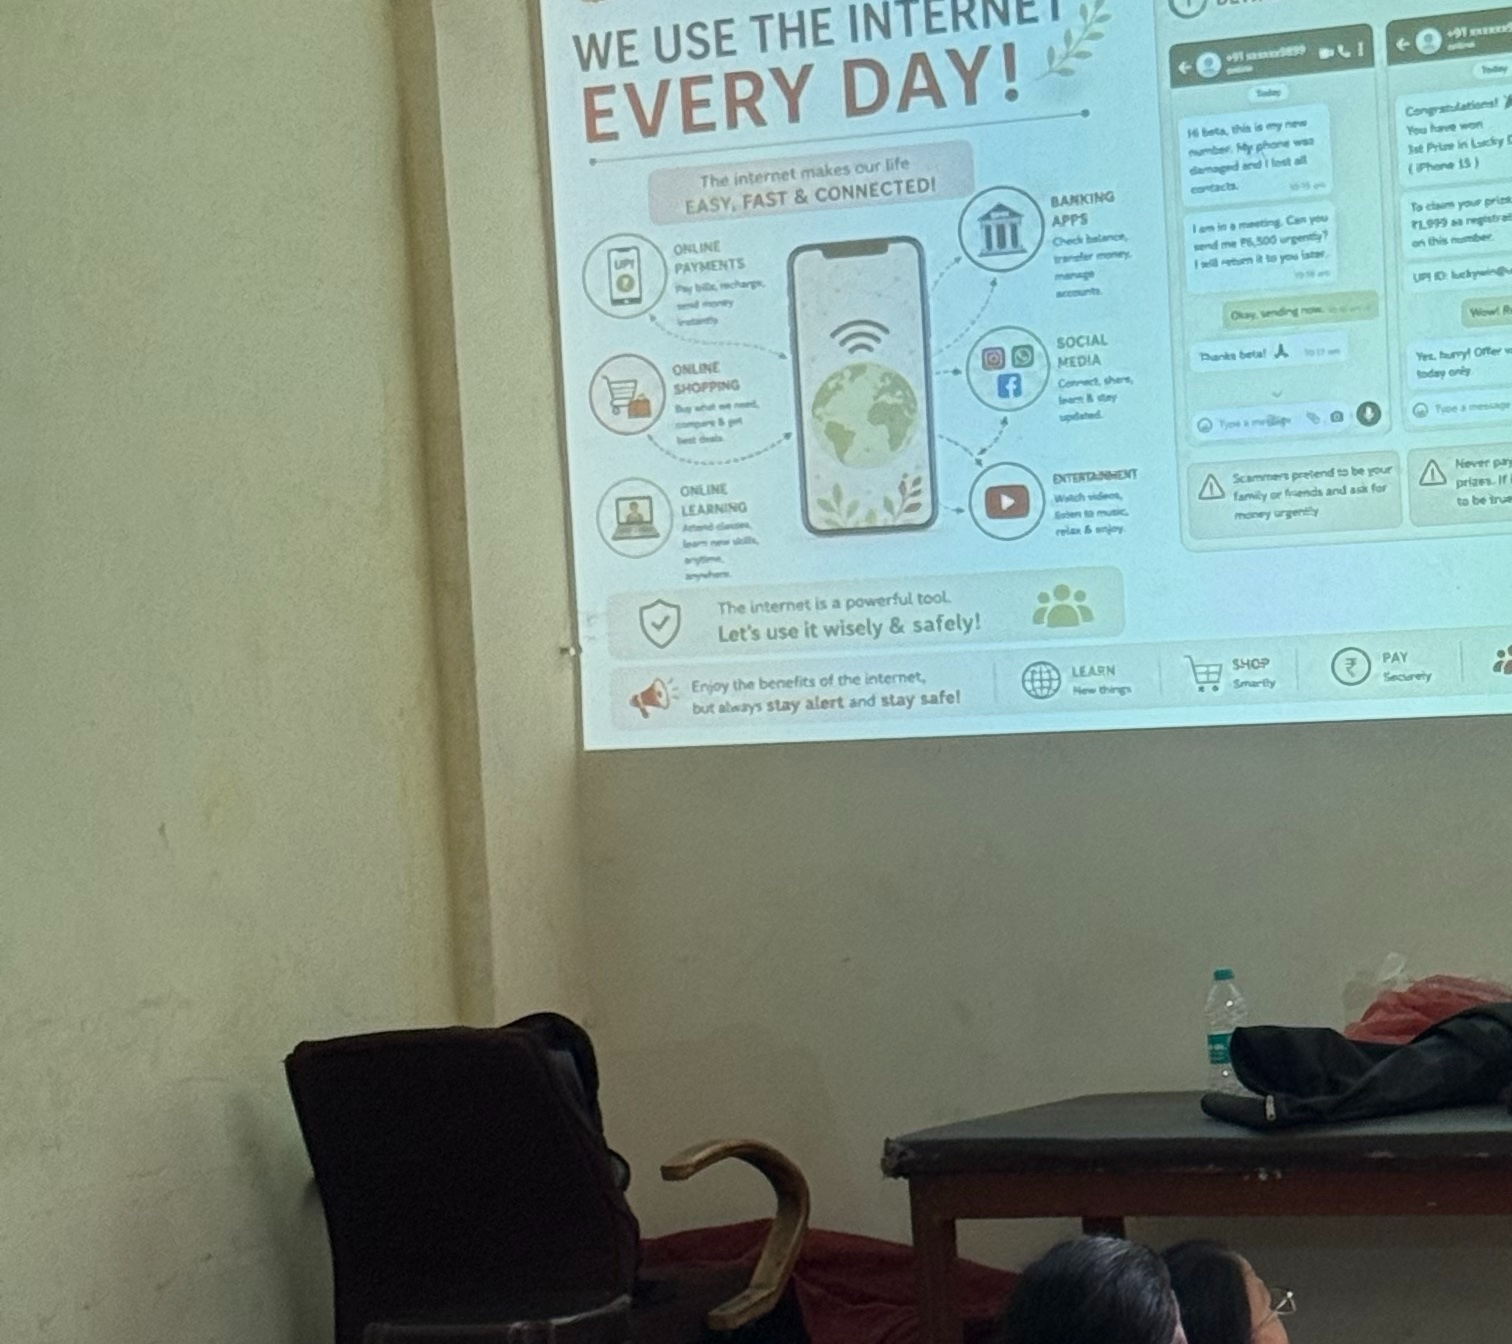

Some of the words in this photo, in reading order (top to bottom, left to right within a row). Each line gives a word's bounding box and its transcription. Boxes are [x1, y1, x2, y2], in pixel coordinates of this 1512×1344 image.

[572, 28, 640, 72] WE
[654, 18, 737, 64] USE
[749, 7, 835, 53] THE
[583, 63, 814, 143] EVERY
[842, 41, 1019, 118] DAY!
[1471, 136, 1504, 149] Lucky
[701, 174, 729, 189] The
[734, 168, 796, 185] internet
[801, 163, 851, 178] makes
[855, 161, 881, 175] our
[886, 157, 910, 171] life
[685, 196, 736, 215] EASY,
[743, 190, 788, 209] FAST
[794, 189, 808, 204] &
[815, 177, 936, 202] CONNECTED!
[1050, 191, 1115, 208] BANKING
[1051, 213, 1088, 228] APPS
[674, 240, 721, 255] ONLINE
[674, 258, 746, 274] PAYMENTS
[1057, 334, 1109, 349] SOCIAL
[672, 361, 720, 376] ONLINE
[1057, 354, 1101, 369] MEDIA
[674, 379, 740, 395] SHOPPING
[1456, 458, 1490, 469] Never
[1232, 473, 1289, 484] Scammers
[1292, 468, 1335, 481] pretend
[1337, 467, 1349, 477] to
[1351, 466, 1365, 475] be
[1367, 465, 1393, 478] your
[1498, 475, 1507, 485] If
[681, 483, 728, 497] ONLINE
[1233, 490, 1268, 502] family
[1270, 492, 1282, 500] or
[1285, 487, 1323, 499] friends
[1326, 485, 1347, 496] and
[1350, 484, 1368, 493] ask
[1371, 484, 1388, 493] for
[1457, 497, 1469, 506] to
[1472, 495, 1487, 505] be
[681, 501, 747, 517] LEARNING
[1234, 510, 1270, 521] money
[1274, 506, 1319, 519] urgently
[717, 601, 746, 616] The
[750, 598, 811, 614] internet
[816, 597, 827, 610] is
[832, 598, 840, 609] a
[846, 592, 912, 610] powerful
[917, 590, 951, 605] tool.
[718, 624, 761, 643] Let's
[766, 626, 799, 640] use
[804, 621, 818, 638] it
[824, 617, 883, 639] wisely
[889, 617, 904, 634] &
[912, 612, 981, 635] safely!
[1232, 657, 1270, 671] SHOP
[1382, 652, 1408, 664] PAY
[1071, 665, 1116, 677] LEARN
[1383, 670, 1432, 683] Securely
[691, 679, 729, 695] Enjoy
[733, 677, 755, 690] the
[759, 674, 816, 689] benefits
[819, 674, 833, 687] of
[838, 673, 861, 686] the
[865, 672, 927, 685] internet,
[1099, 684, 1132, 696] things
[692, 702, 714, 715] but
[718, 702, 762, 716] always
[766, 698, 801, 714] stay
[805, 695, 844, 710] alert
[849, 695, 876, 708] and
[881, 693, 916, 709] stay
[920, 689, 961, 705] safe!
